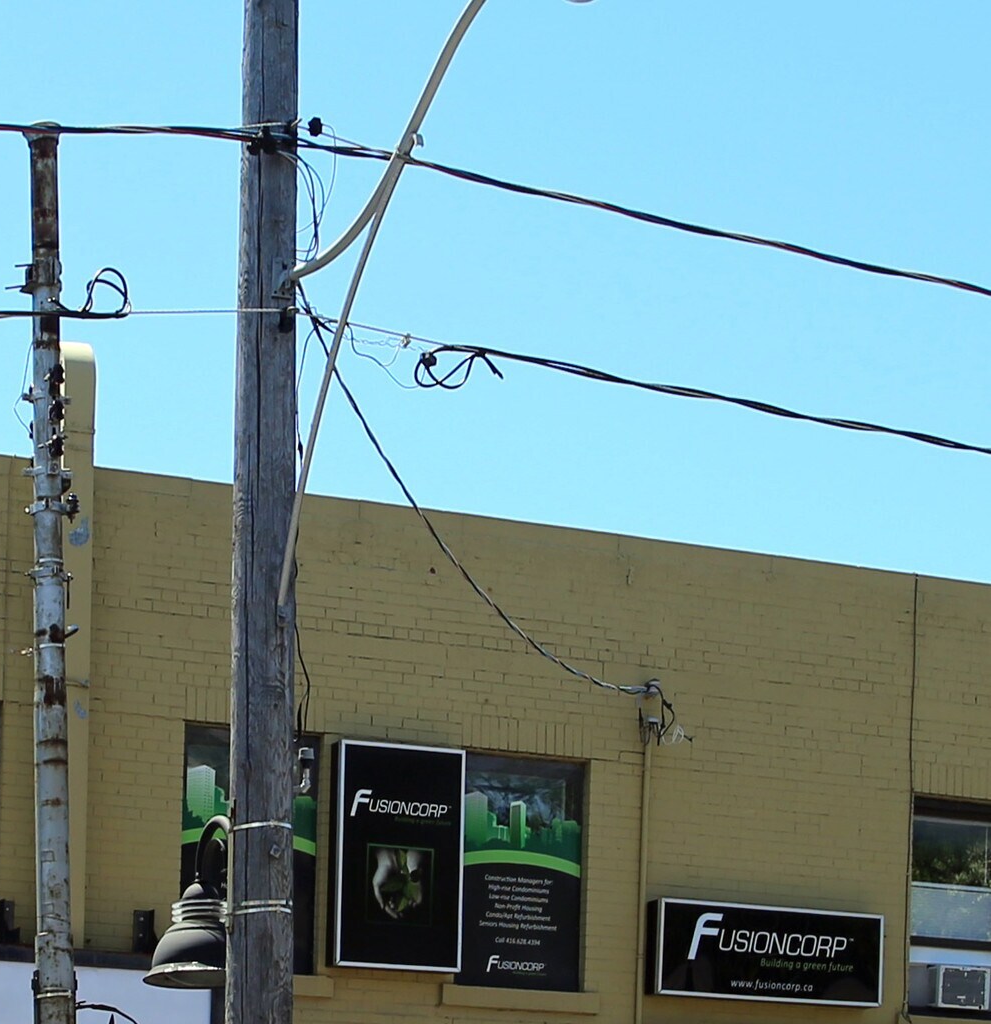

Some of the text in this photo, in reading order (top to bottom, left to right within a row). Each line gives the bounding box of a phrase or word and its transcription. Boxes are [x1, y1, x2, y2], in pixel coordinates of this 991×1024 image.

[350, 788, 450, 818] FUSIONCORP
[484, 874, 517, 883] Construction
[518, 877, 543, 886] Managers
[512, 886, 550, 894] Condominiums
[511, 895, 549, 903] Condominiums
[494, 903, 543, 913] Non-Profit Housing
[514, 913, 551, 921] Refurbishment
[499, 922, 519, 930] Housing
[520, 923, 558, 932] Refurbishment
[495, 936, 505, 944] Call
[687, 912, 848, 960] FUSIONCORP
[486, 955, 545, 973] FUSIONCORP
[760, 959, 854, 973] Building a green future
[730, 979, 813, 993] www.fusioncorp.ca
